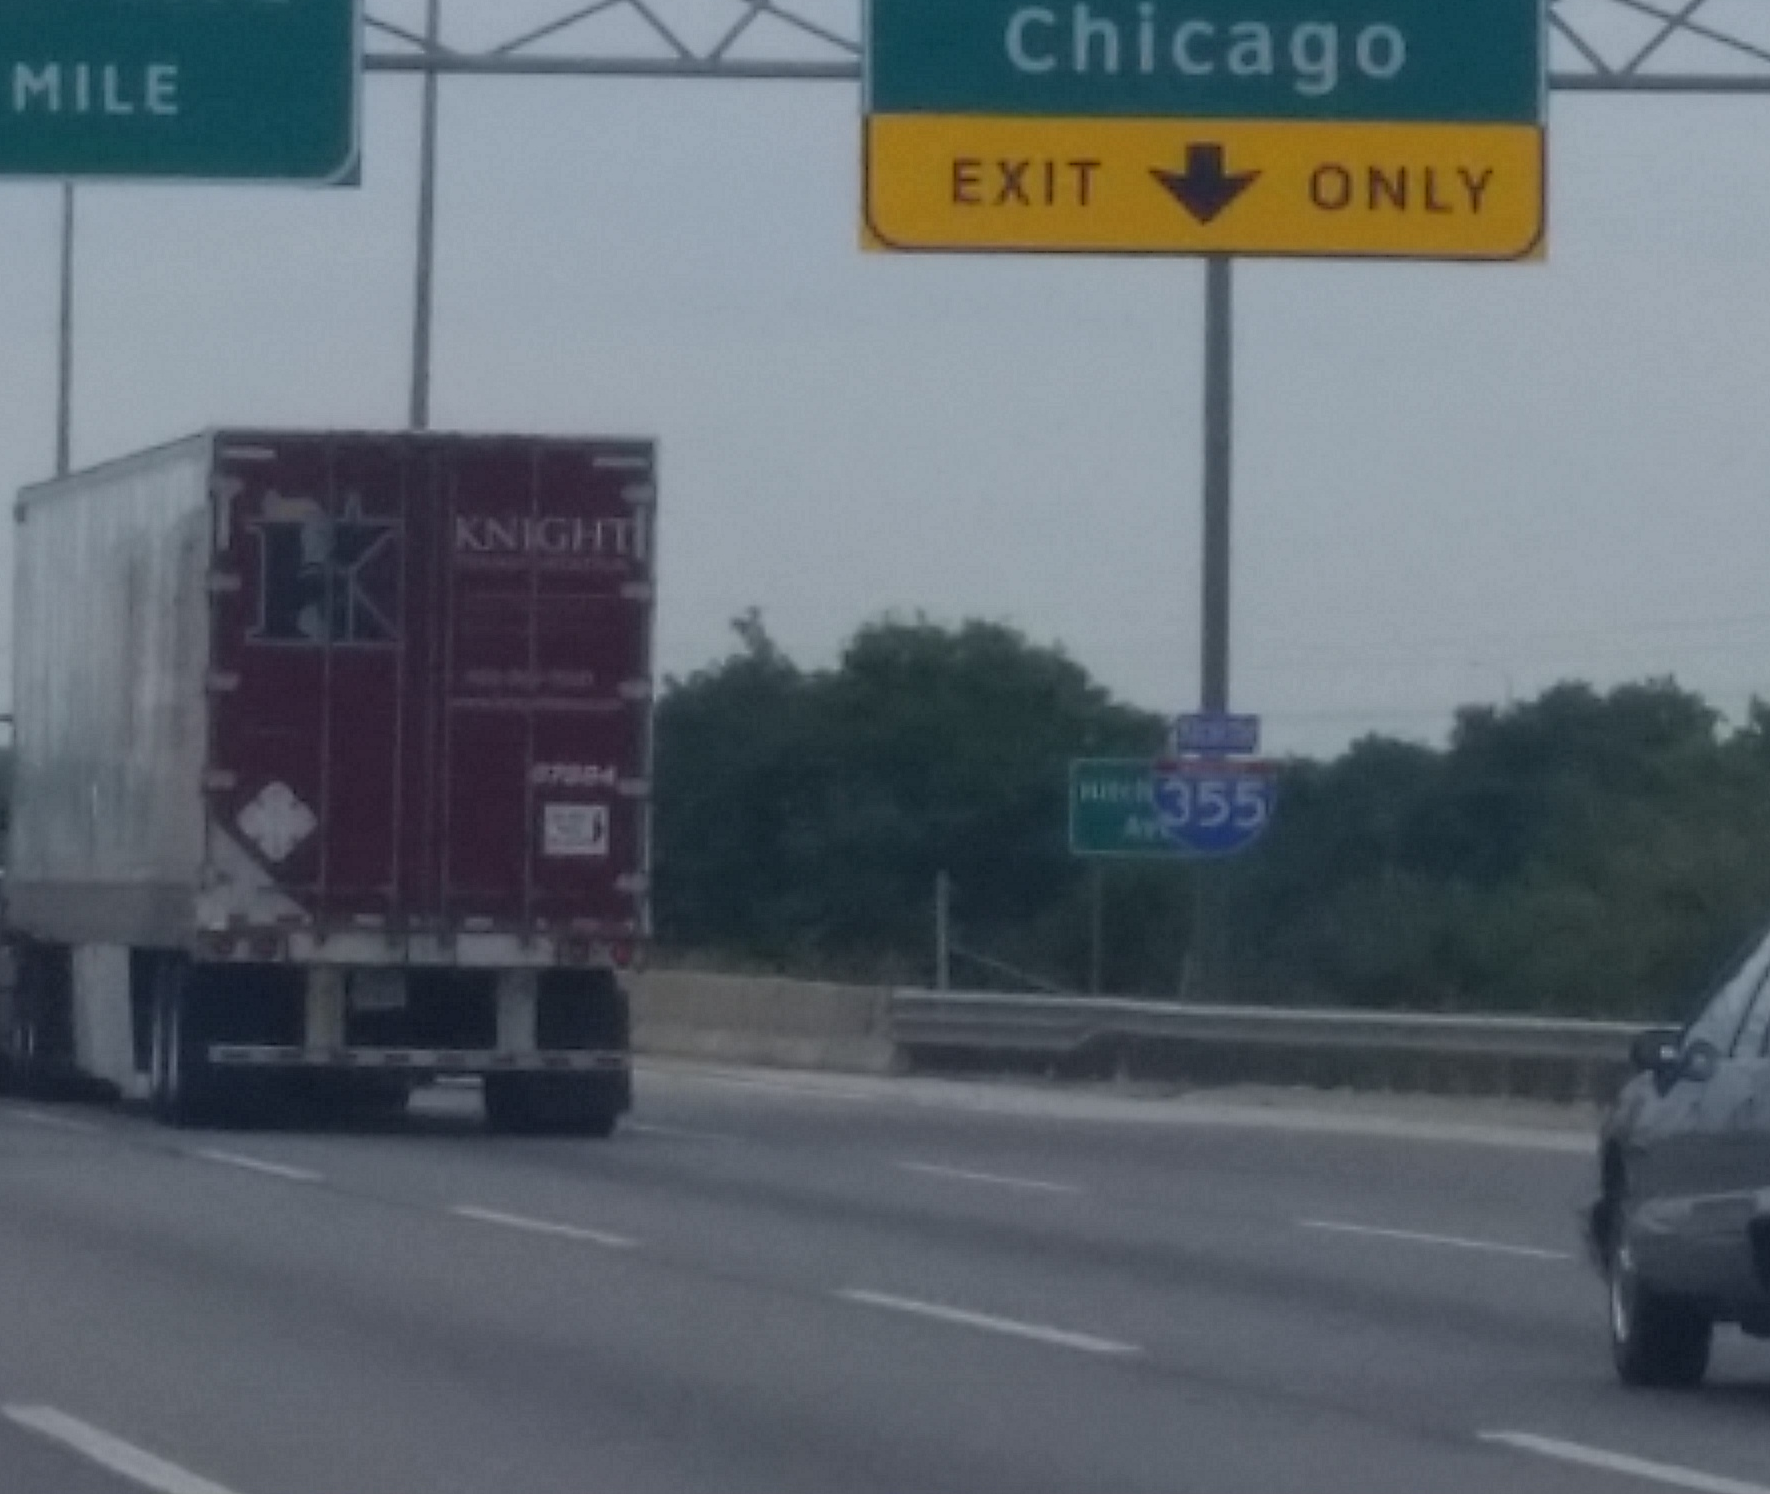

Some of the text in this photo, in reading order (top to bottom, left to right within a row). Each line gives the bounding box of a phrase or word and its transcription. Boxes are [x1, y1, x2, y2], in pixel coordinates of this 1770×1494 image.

[1004, 2, 1407, 97] Chicago
[10, 62, 181, 116] MILE
[950, 156, 1494, 215] EXIT ONLY
[454, 514, 635, 555] KNIGHT
[1158, 779, 1267, 830] 355
